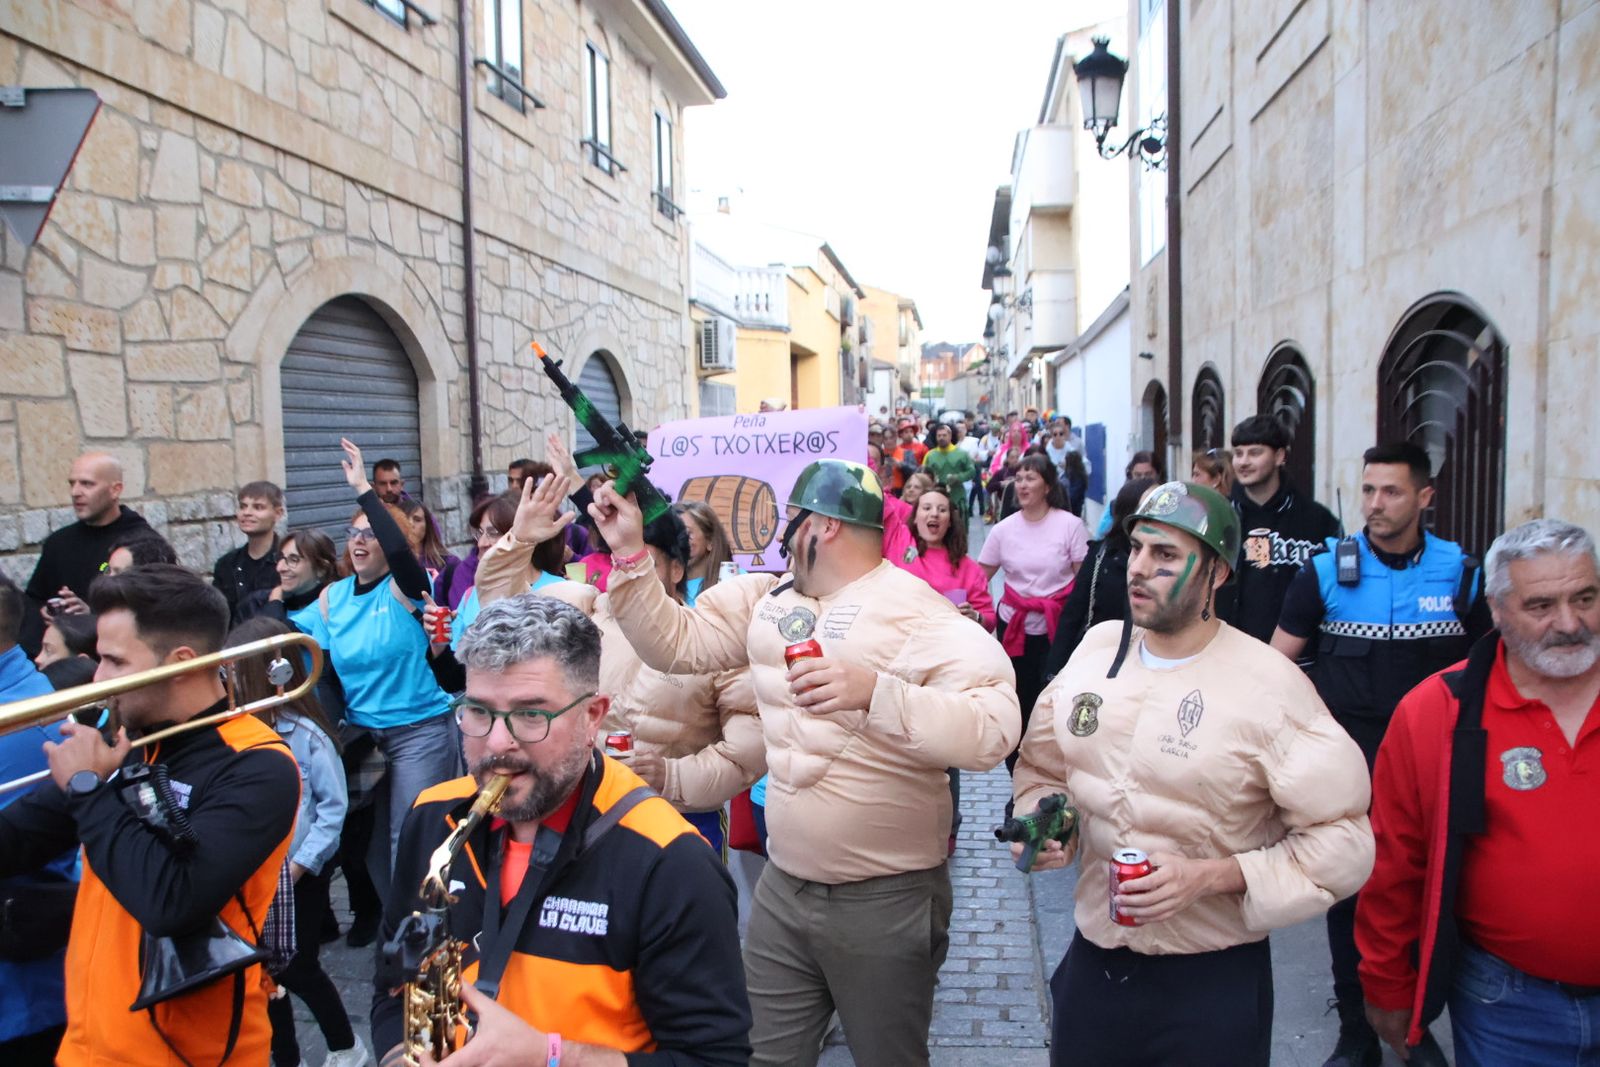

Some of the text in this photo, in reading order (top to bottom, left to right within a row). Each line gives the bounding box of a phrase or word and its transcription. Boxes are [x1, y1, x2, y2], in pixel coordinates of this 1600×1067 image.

[733, 415, 767, 429] Peña
[660, 430, 840, 458] L@S TXOTXER@S
[1418, 596, 1453, 612] POLIC
[539, 910, 609, 935] LA CLAVE
